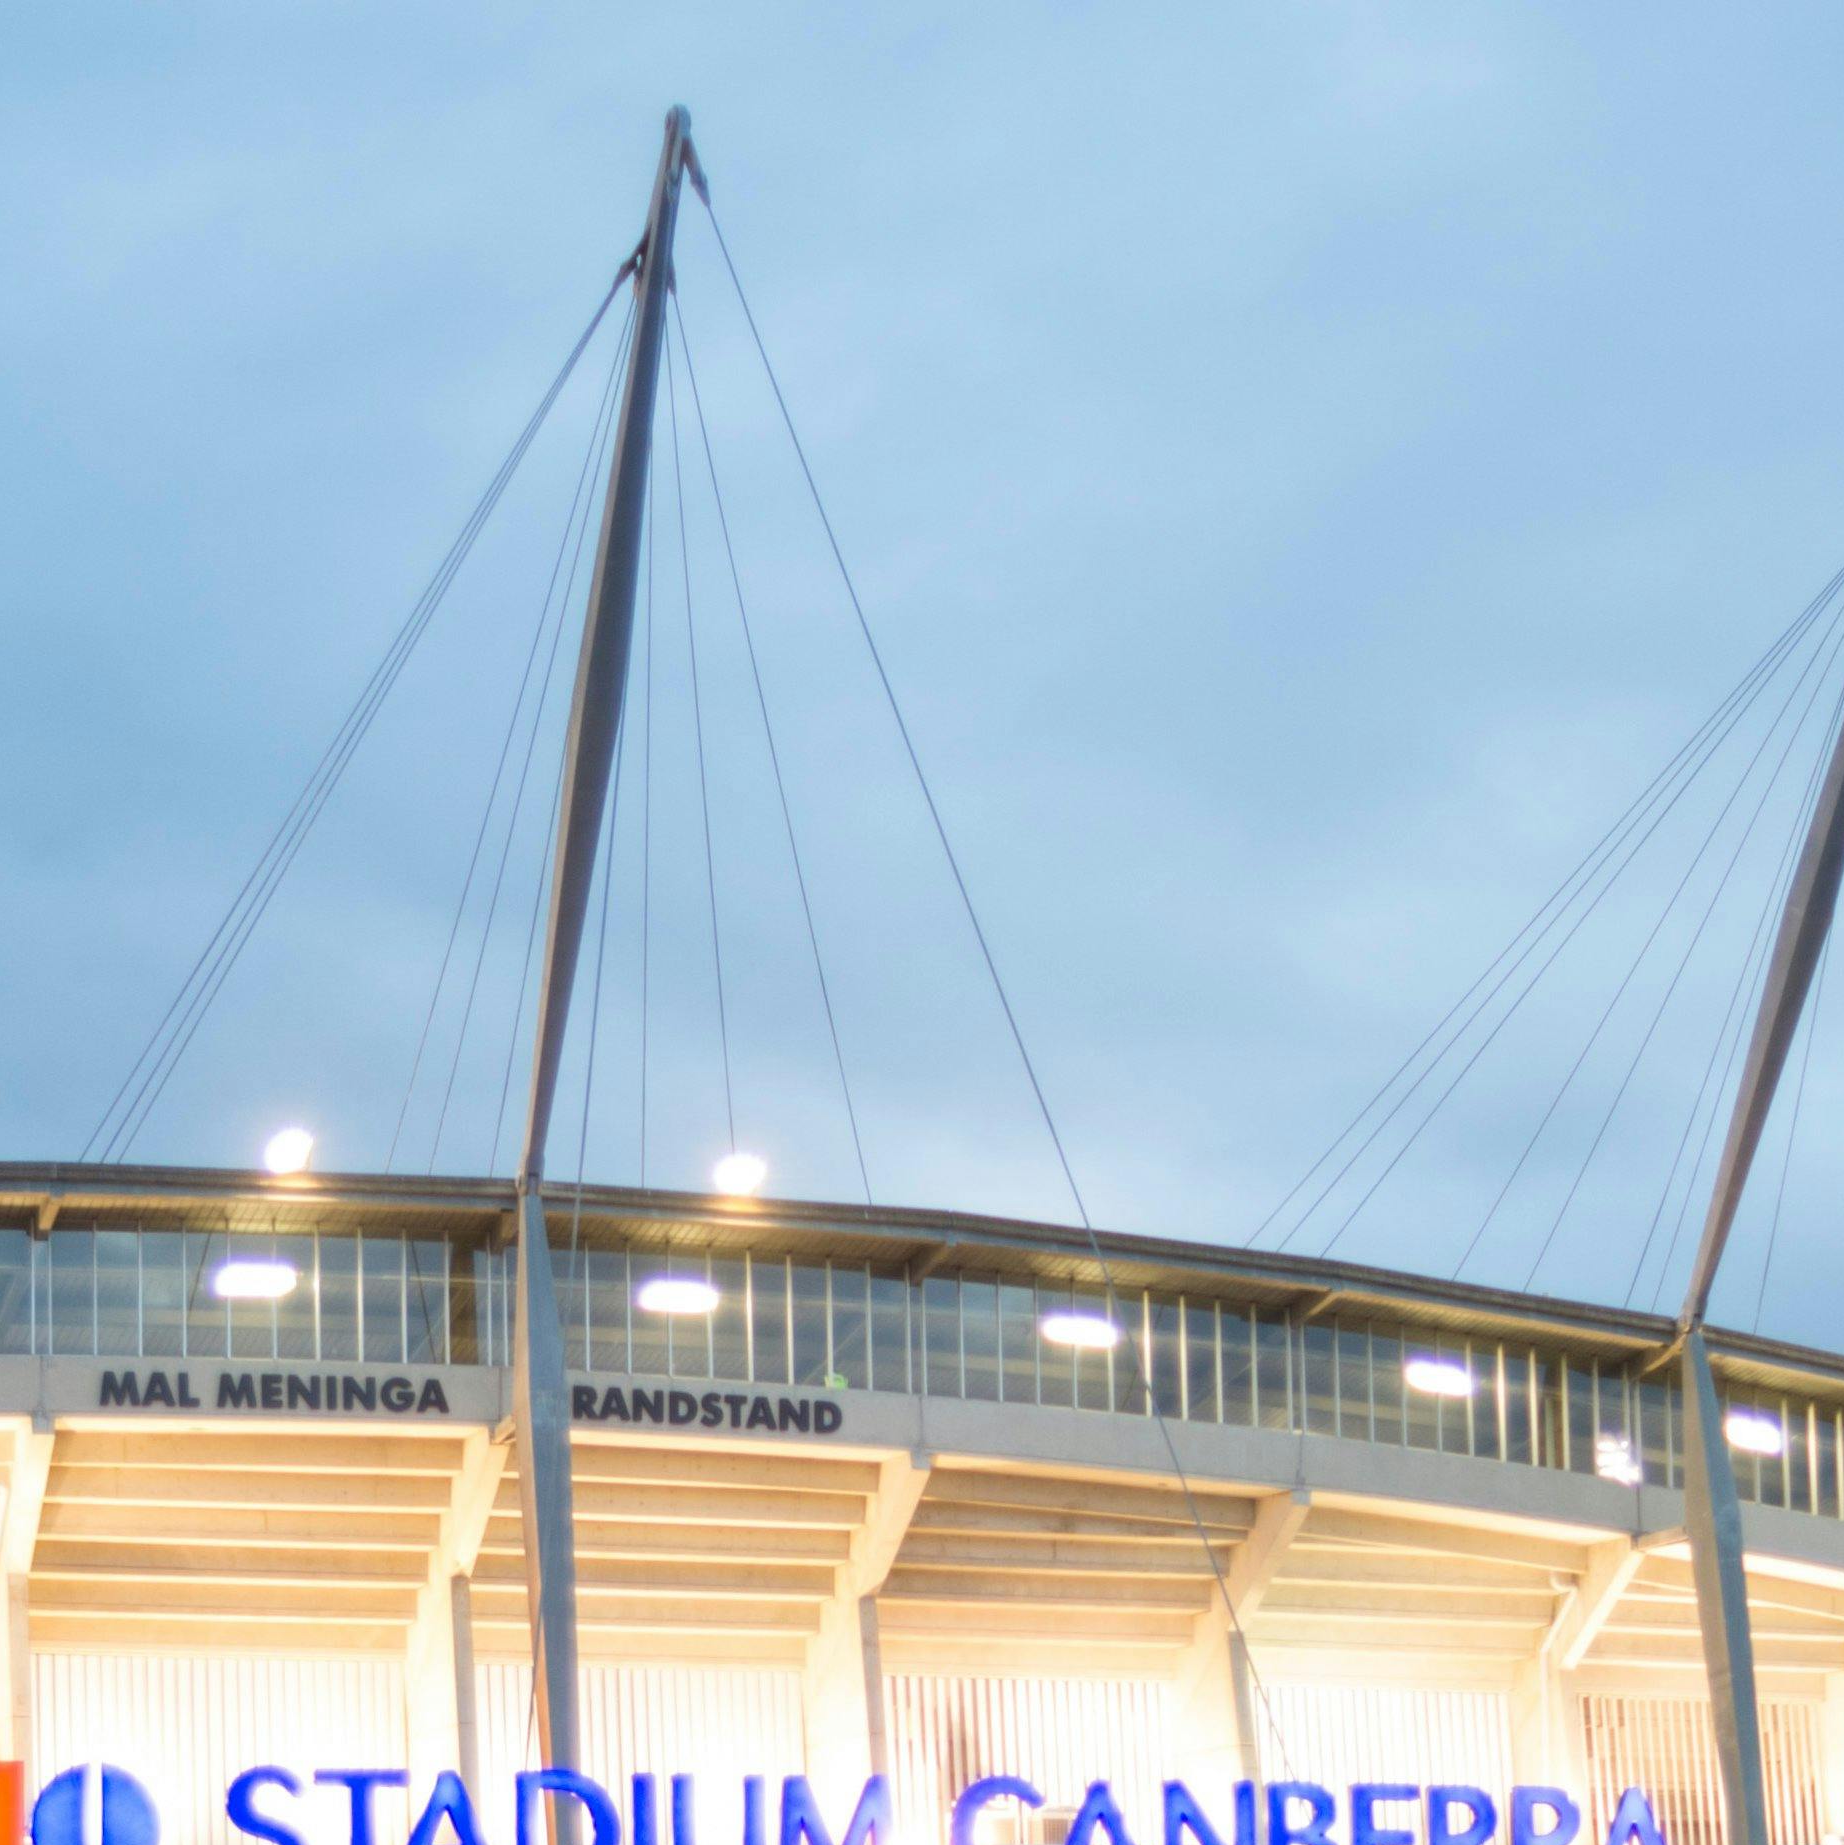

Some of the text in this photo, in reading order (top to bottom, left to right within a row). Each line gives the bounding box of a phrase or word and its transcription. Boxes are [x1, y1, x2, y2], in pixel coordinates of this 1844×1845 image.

[99, 1370, 843, 1434] MAL MENINGA RANDSTAND
